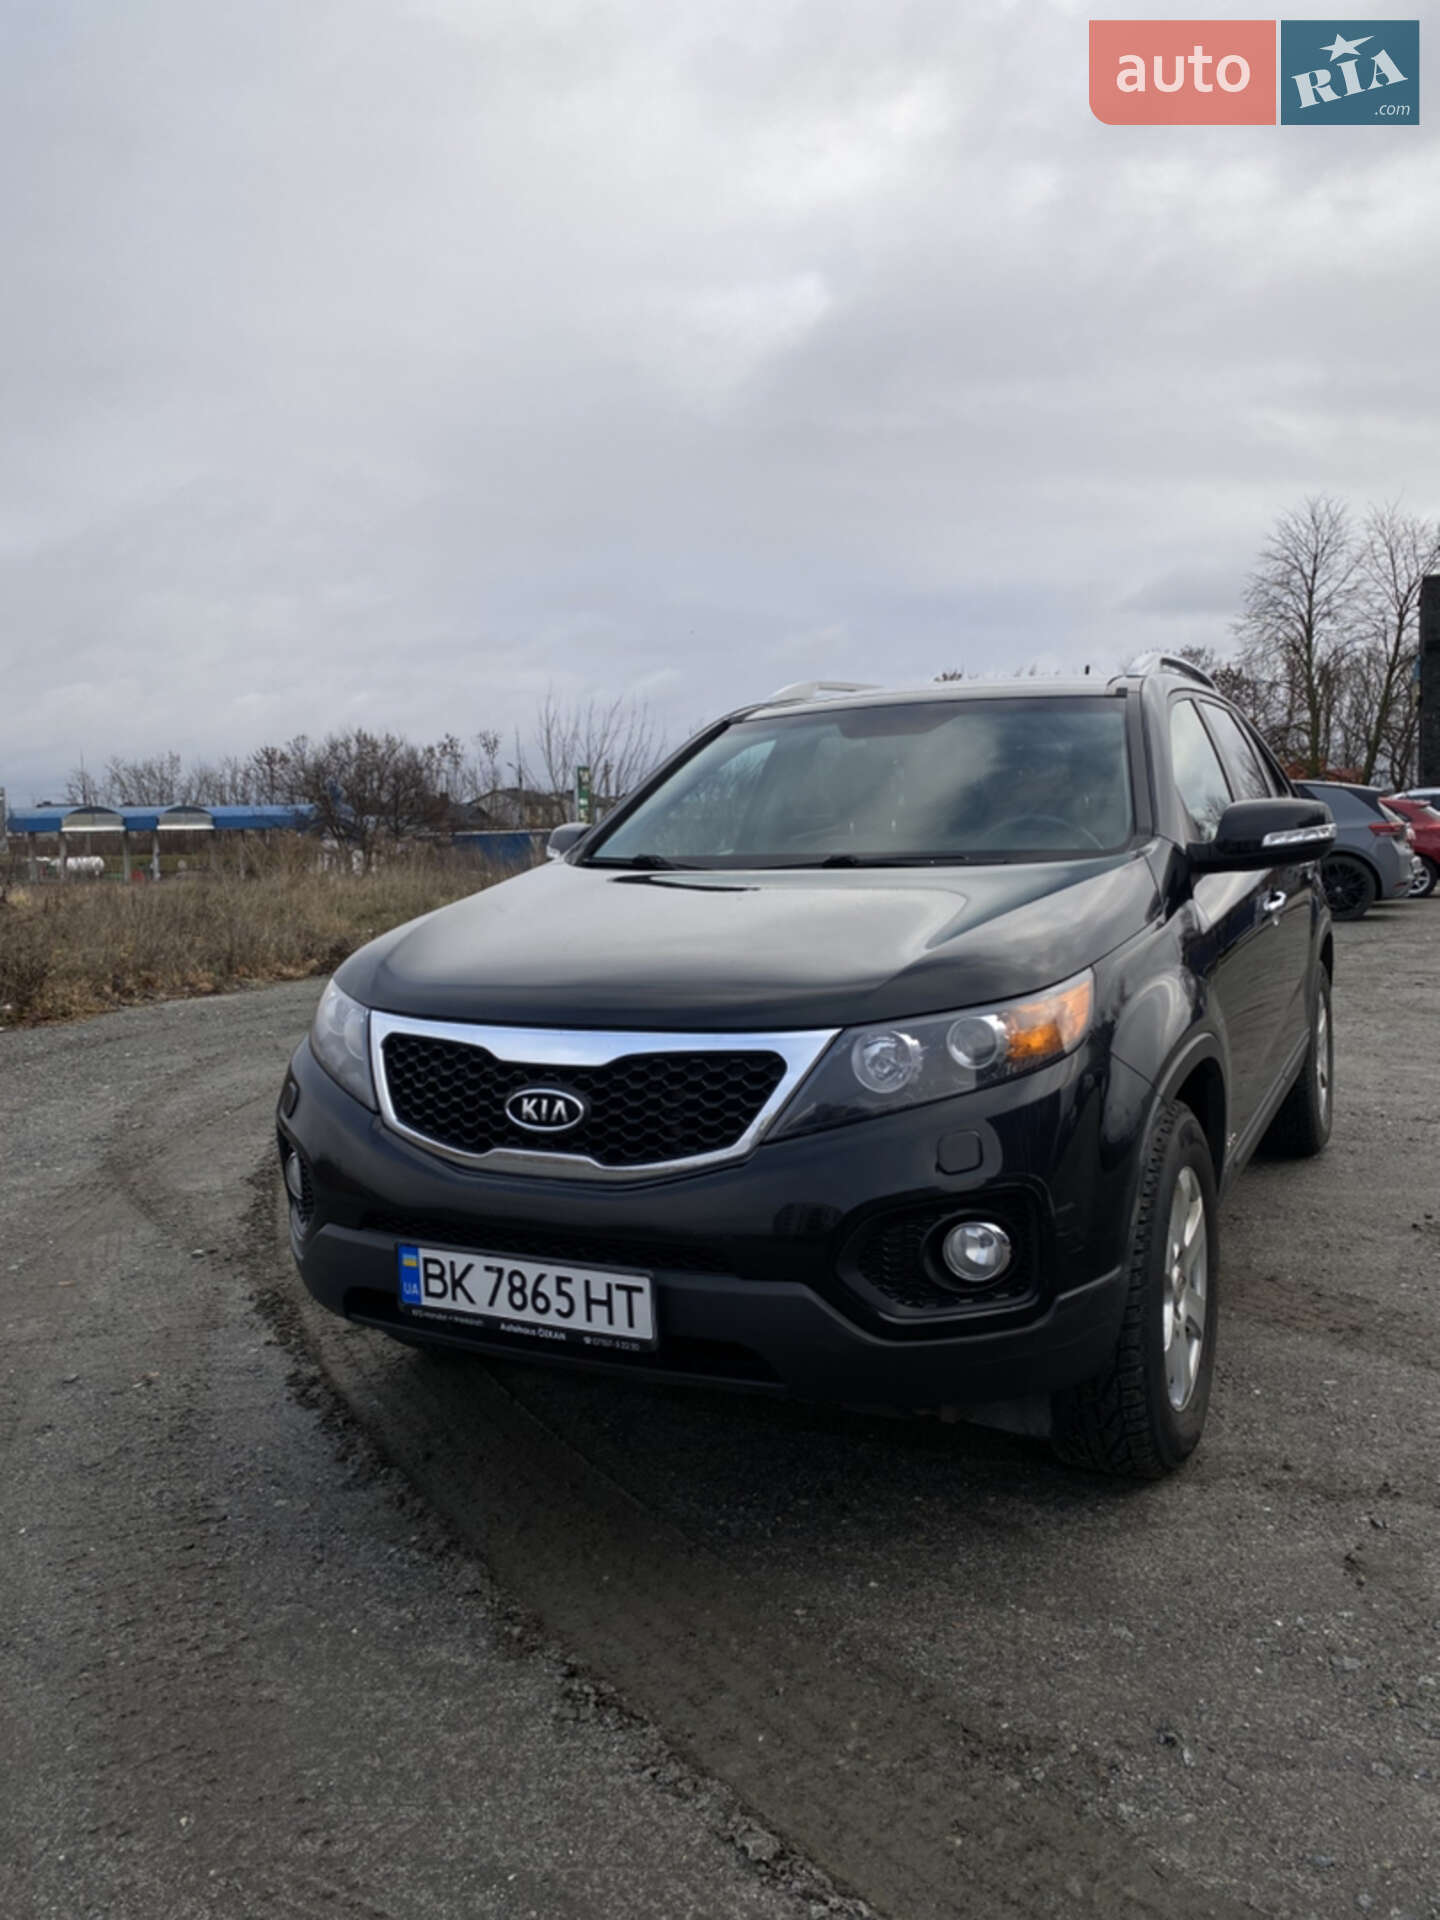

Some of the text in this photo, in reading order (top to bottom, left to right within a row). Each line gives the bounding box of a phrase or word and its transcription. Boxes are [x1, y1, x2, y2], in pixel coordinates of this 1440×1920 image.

[521, 1097, 569, 1122] KIA
[403, 1282, 419, 1296] UA
[422, 1257, 645, 1329] BK 7865 HT
